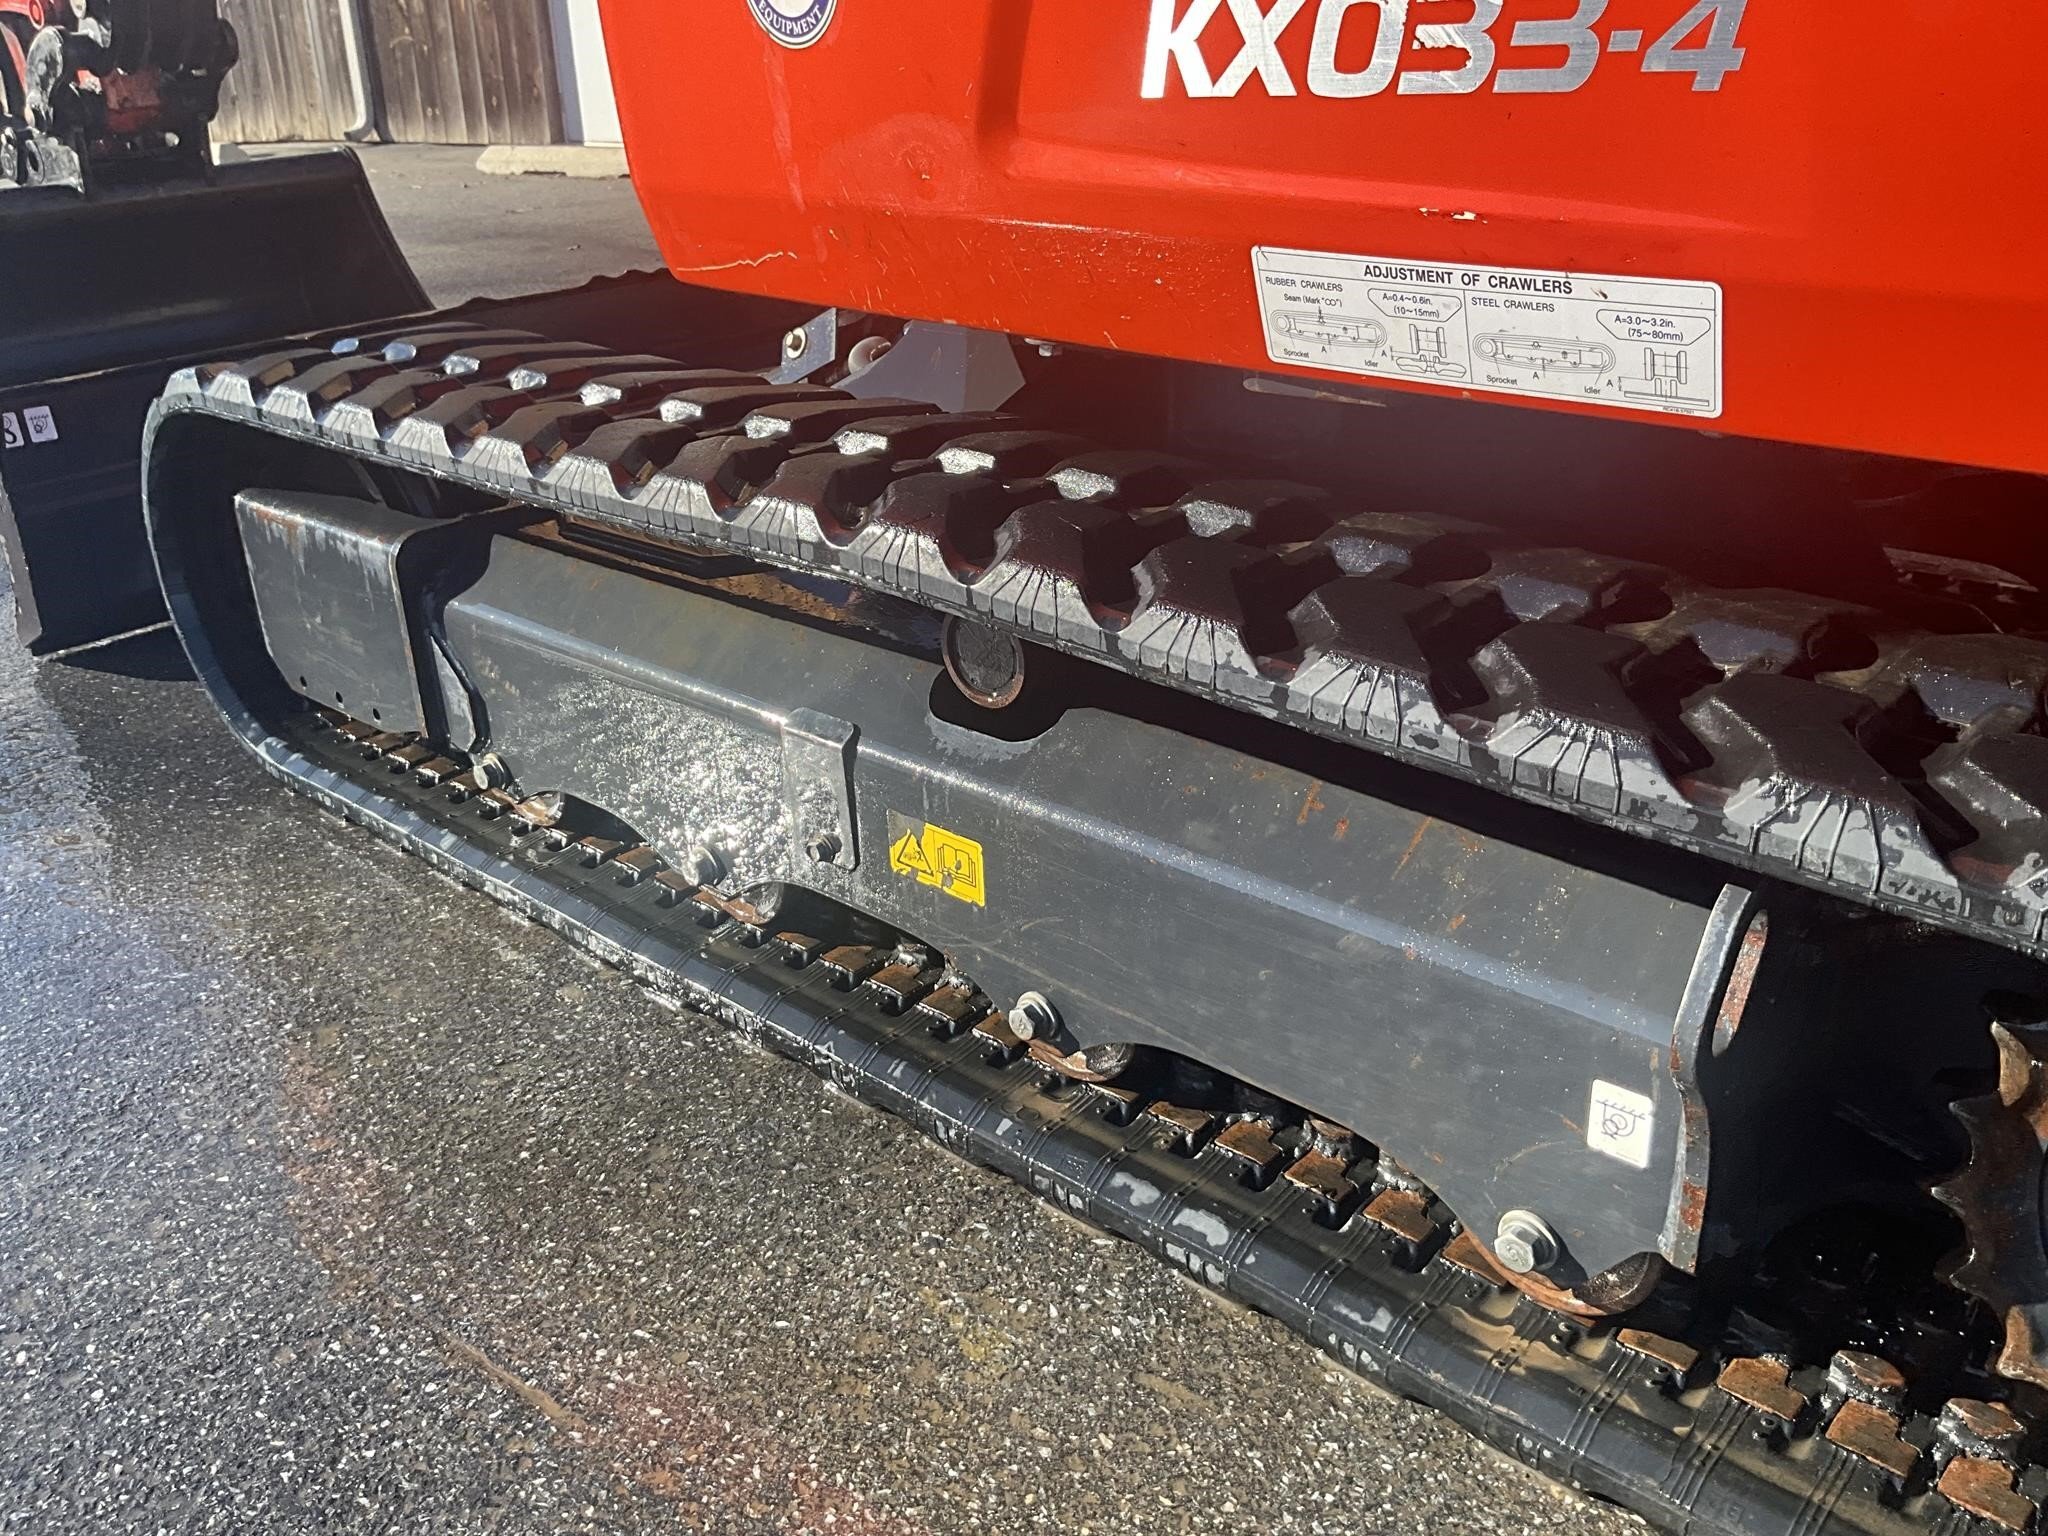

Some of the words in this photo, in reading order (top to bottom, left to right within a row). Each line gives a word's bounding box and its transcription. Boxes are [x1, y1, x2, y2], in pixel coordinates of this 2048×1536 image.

[759, 1, 822, 36] EQUIPMENT
[1265, 276, 1297, 288] RUBBER
[1300, 279, 1343, 293] CRAWLERS
[1363, 264, 1453, 285] ADJUSTMENT
[1461, 272, 1480, 287] OF
[1488, 275, 1573, 295] CRAWLERS
[1283, 293, 1301, 303] Seam
[1471, 296, 1500, 308] STEEL
[1503, 299, 1555, 313] CRAWLERS
[1283, 348, 1310, 359] Sprocket
[1321, 345, 1328, 354] A
[1381, 349, 1388, 358] A
[1364, 359, 1379, 368] Idler
[1486, 374, 1518, 386] Sprocket
[1532, 371, 1540, 380] A
[1606, 379, 1614, 388] A
[1584, 385, 1601, 395] Idler
